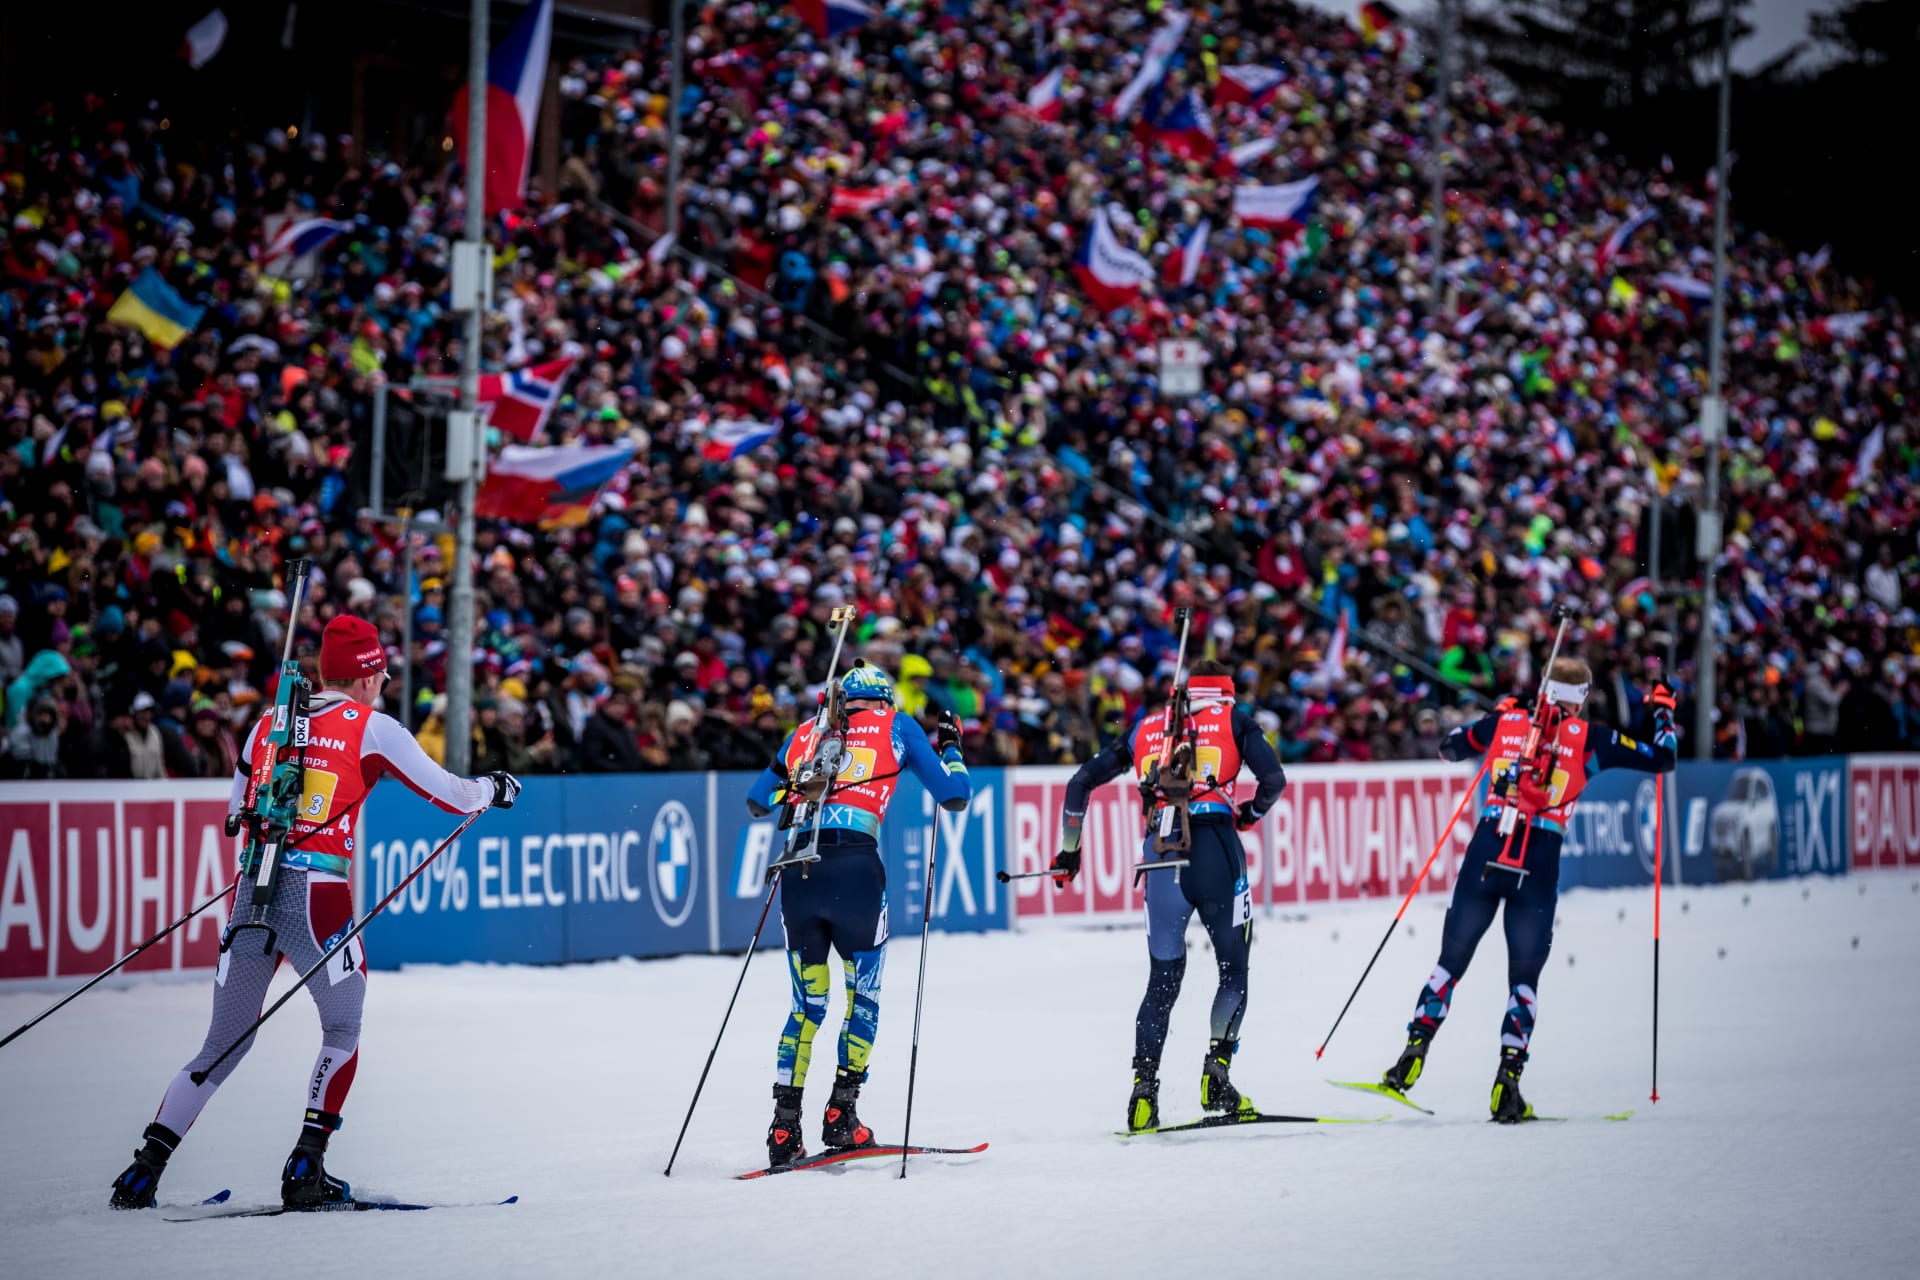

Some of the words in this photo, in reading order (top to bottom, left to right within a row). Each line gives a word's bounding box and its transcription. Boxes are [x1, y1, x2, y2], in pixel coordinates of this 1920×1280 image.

[297, 718, 306, 745] JOKA
[852, 762, 867, 779] 3
[308, 794, 325, 816] 3
[821, 806, 853, 826] iX1
[338, 814, 350, 834] 4
[1796, 769, 1841, 871] iX1
[922, 784, 997, 918] iX1
[1272, 790, 1475, 888] BAUHAUS
[370, 838, 470, 915] 100%
[478, 829, 642, 909] ELECTRIC
[1243, 891, 1250, 920] 5
[343, 944, 355, 973] 4
[311, 1056, 332, 1100] SCATTA
